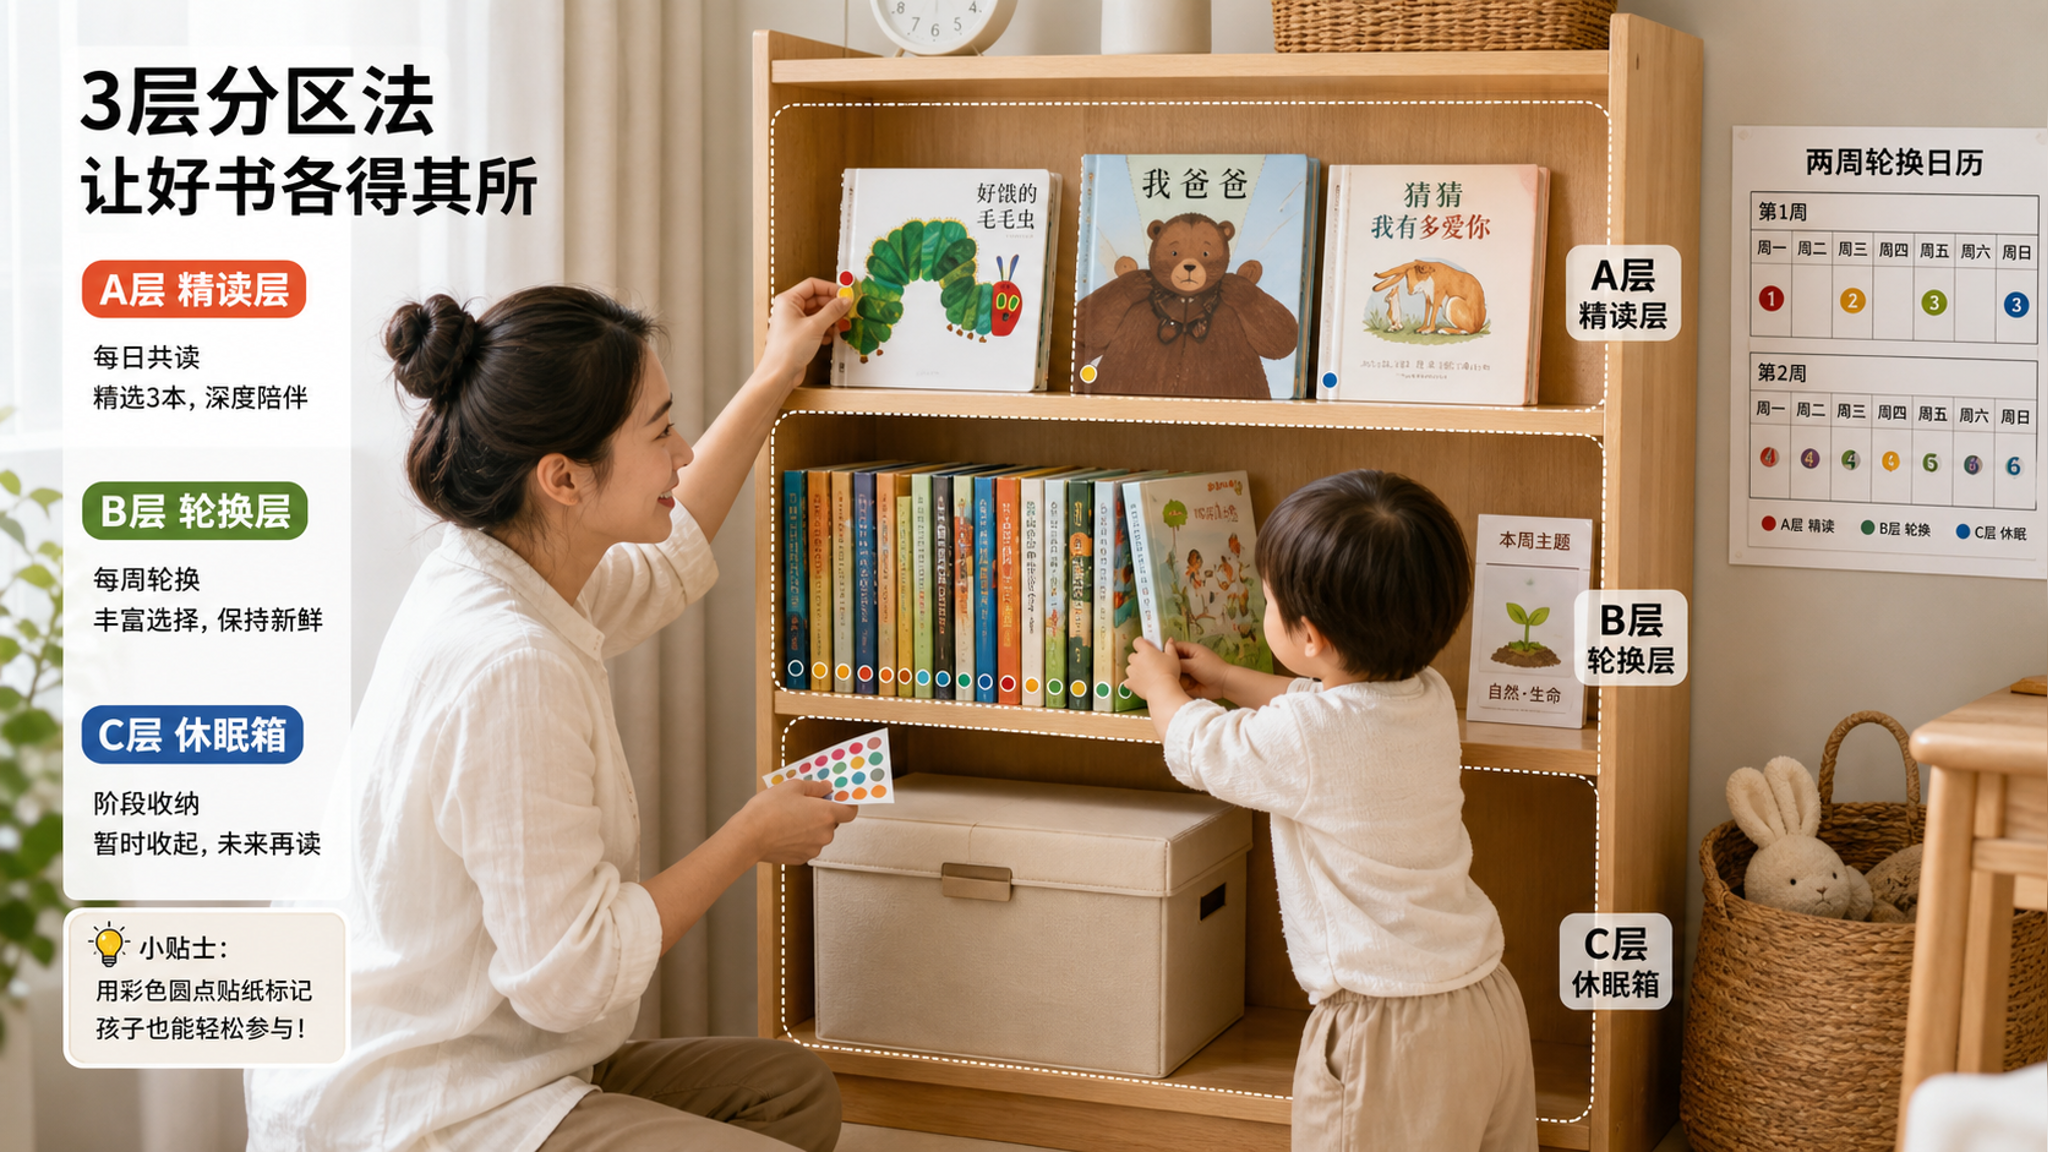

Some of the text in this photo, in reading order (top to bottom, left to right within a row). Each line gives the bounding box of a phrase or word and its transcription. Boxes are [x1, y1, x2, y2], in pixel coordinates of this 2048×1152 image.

[896, 1, 906, 15] 8
[968, 1, 977, 13] 4
[911, 16, 921, 32] 7
[930, 22, 940, 37] 6
[953, 16, 962, 32] 5
[1806, 147, 1984, 177] 两周轮换日历
[1142, 168, 1248, 200] 我爸爸
[1403, 180, 1463, 209] 猜猜
[977, 208, 1035, 230] 毛毛虫
[1758, 201, 1807, 222] 第1周
[1369, 213, 1493, 242] 我有多爱你
[1757, 239, 2031, 262] 周一 周二 周三 周四 周五 周六 周日
[1766, 289, 2023, 314] 1 2 3 3
[1757, 362, 1807, 383] 第2周
[1756, 400, 2030, 426] 周一 周二 周三 周四 周五 周六 周日
[2006, 456, 2021, 476] 6
[1780, 517, 1835, 534] A层 精读
[1879, 521, 1931, 537] B层 轮换
[1974, 525, 2027, 541] C层 休眠
[1499, 530, 1571, 552] 本周主题
[1488, 682, 1562, 705] 自然·生命
